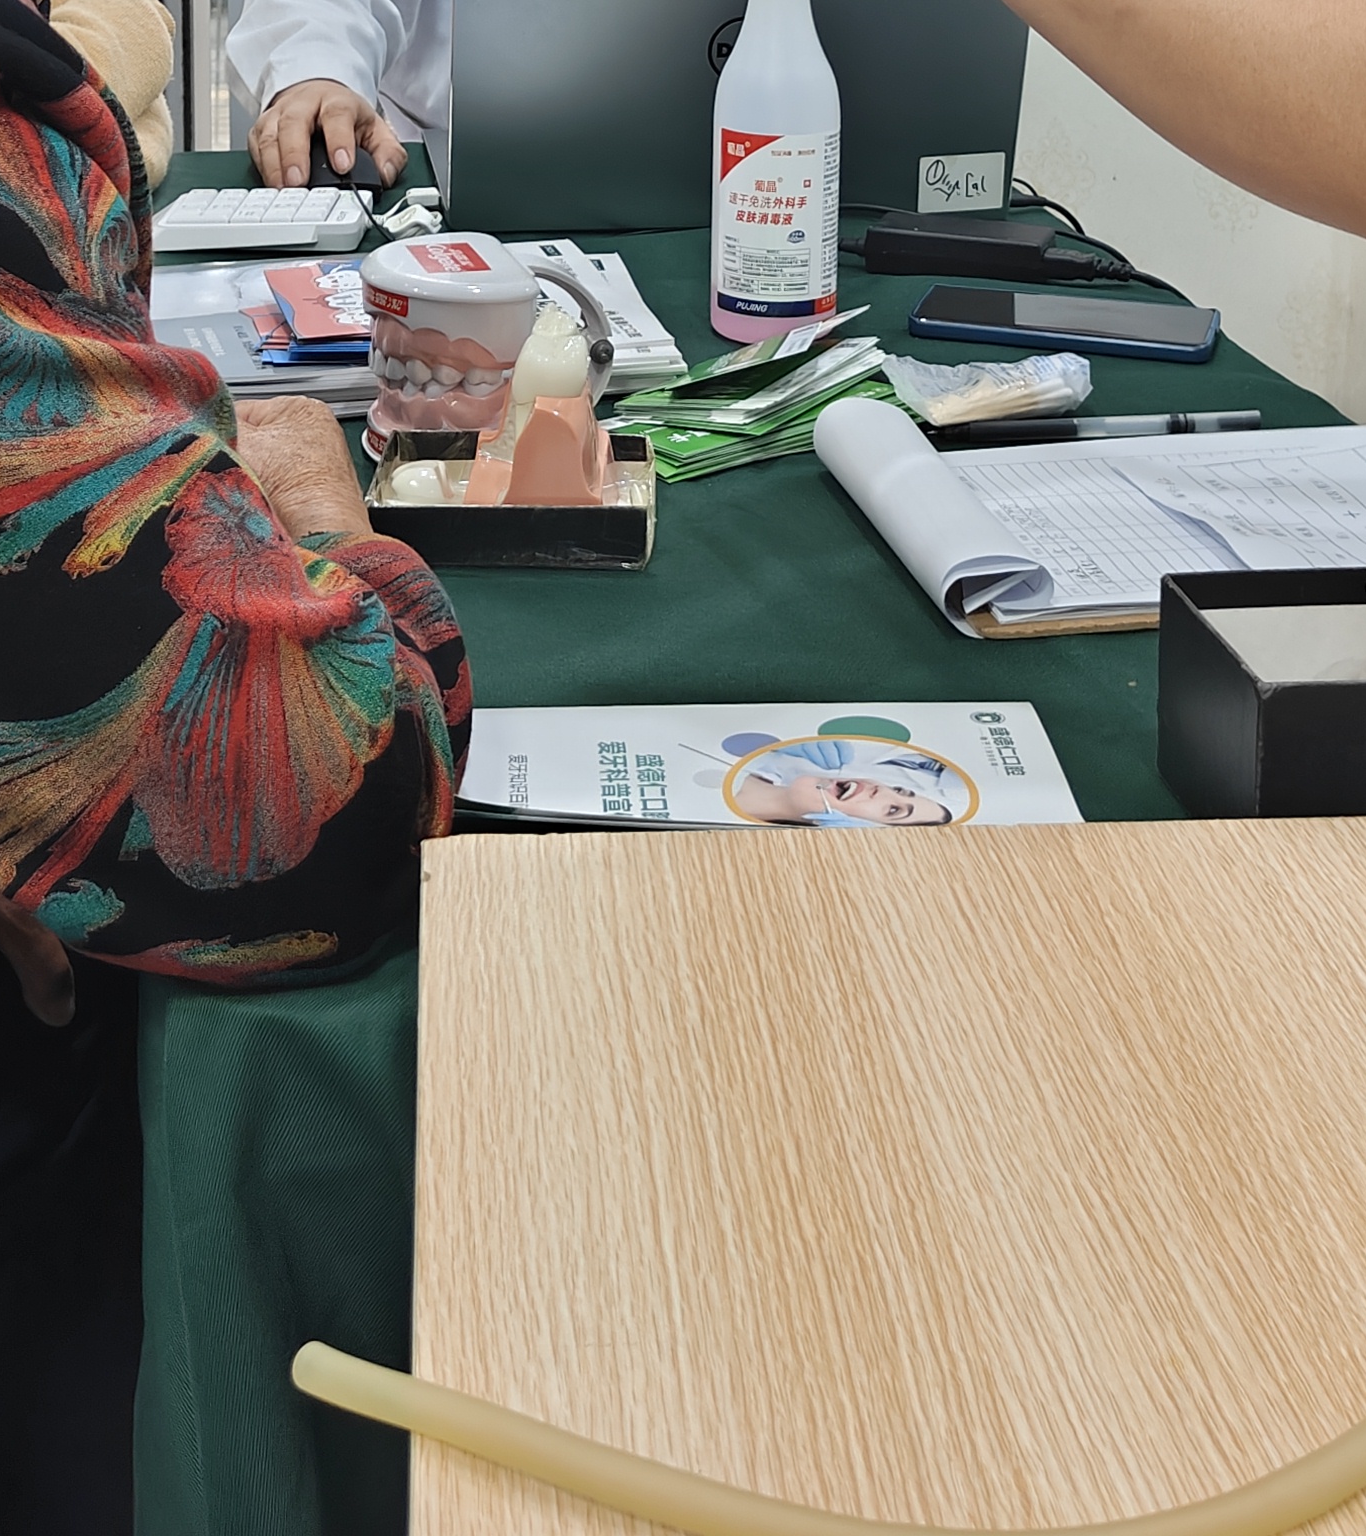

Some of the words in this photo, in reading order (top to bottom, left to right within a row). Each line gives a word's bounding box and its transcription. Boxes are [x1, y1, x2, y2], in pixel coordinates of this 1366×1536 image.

[734, 209, 794, 226] 皮肤消毒液
[735, 300, 769, 313] PUJING
[507, 753, 530, 808] 爱牙知识百
[597, 740, 634, 816] 爱牙科普宣
